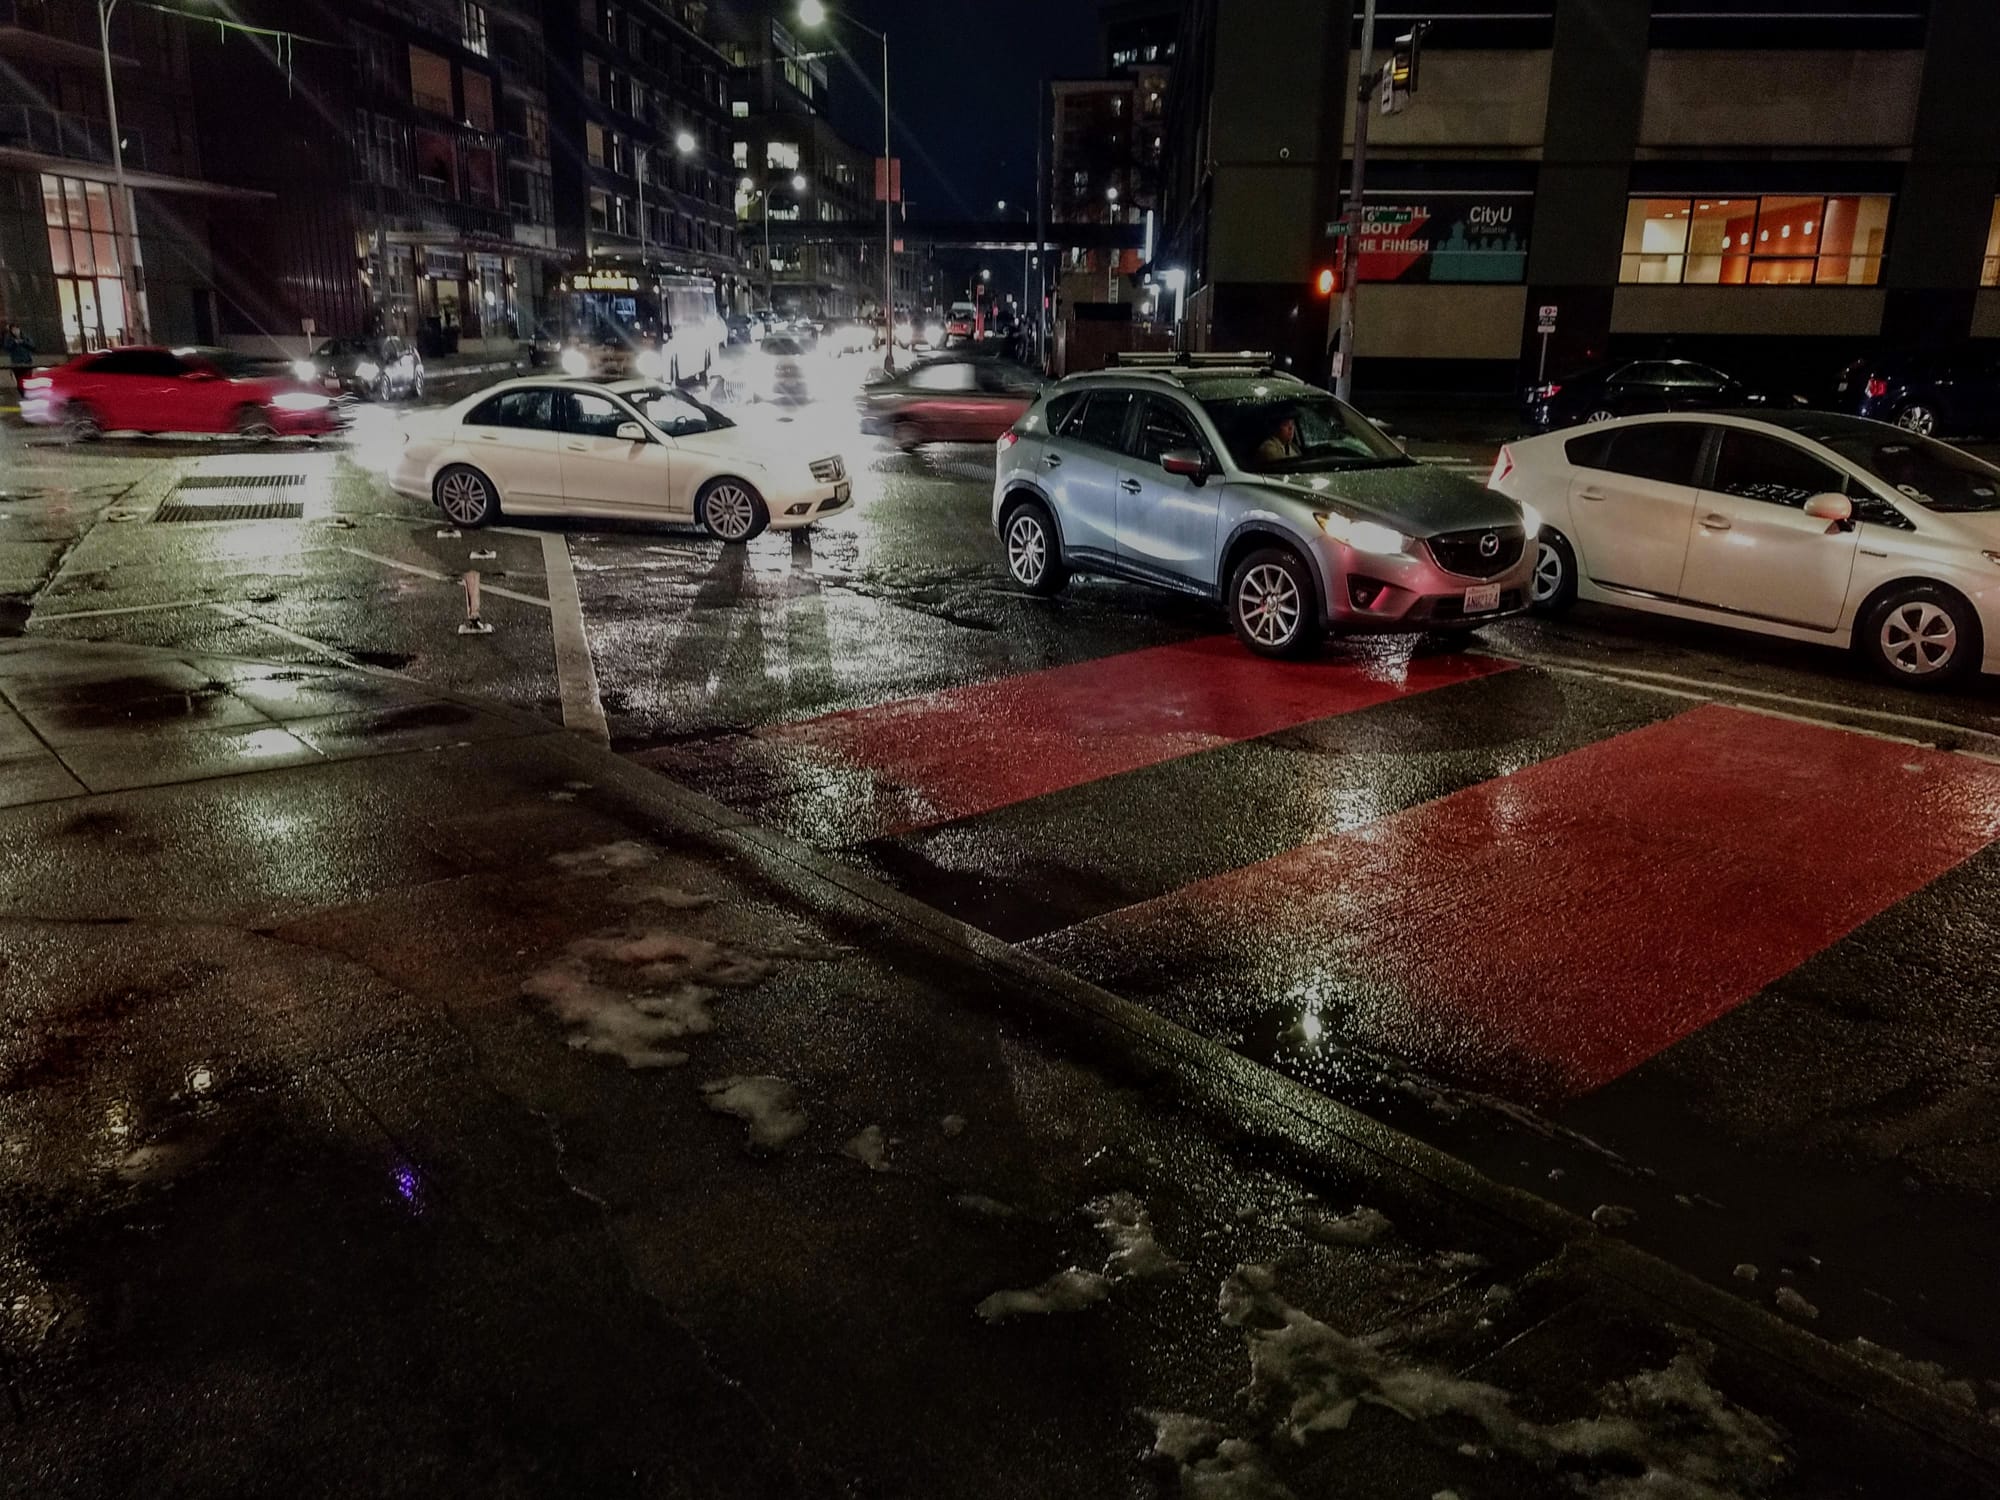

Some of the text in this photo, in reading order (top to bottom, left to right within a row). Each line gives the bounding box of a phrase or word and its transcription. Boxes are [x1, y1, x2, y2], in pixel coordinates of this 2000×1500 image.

[1469, 205, 1513, 226] CityU
[1360, 223, 1402, 235] BOUT
[1358, 239, 1429, 252] HE FINISH
